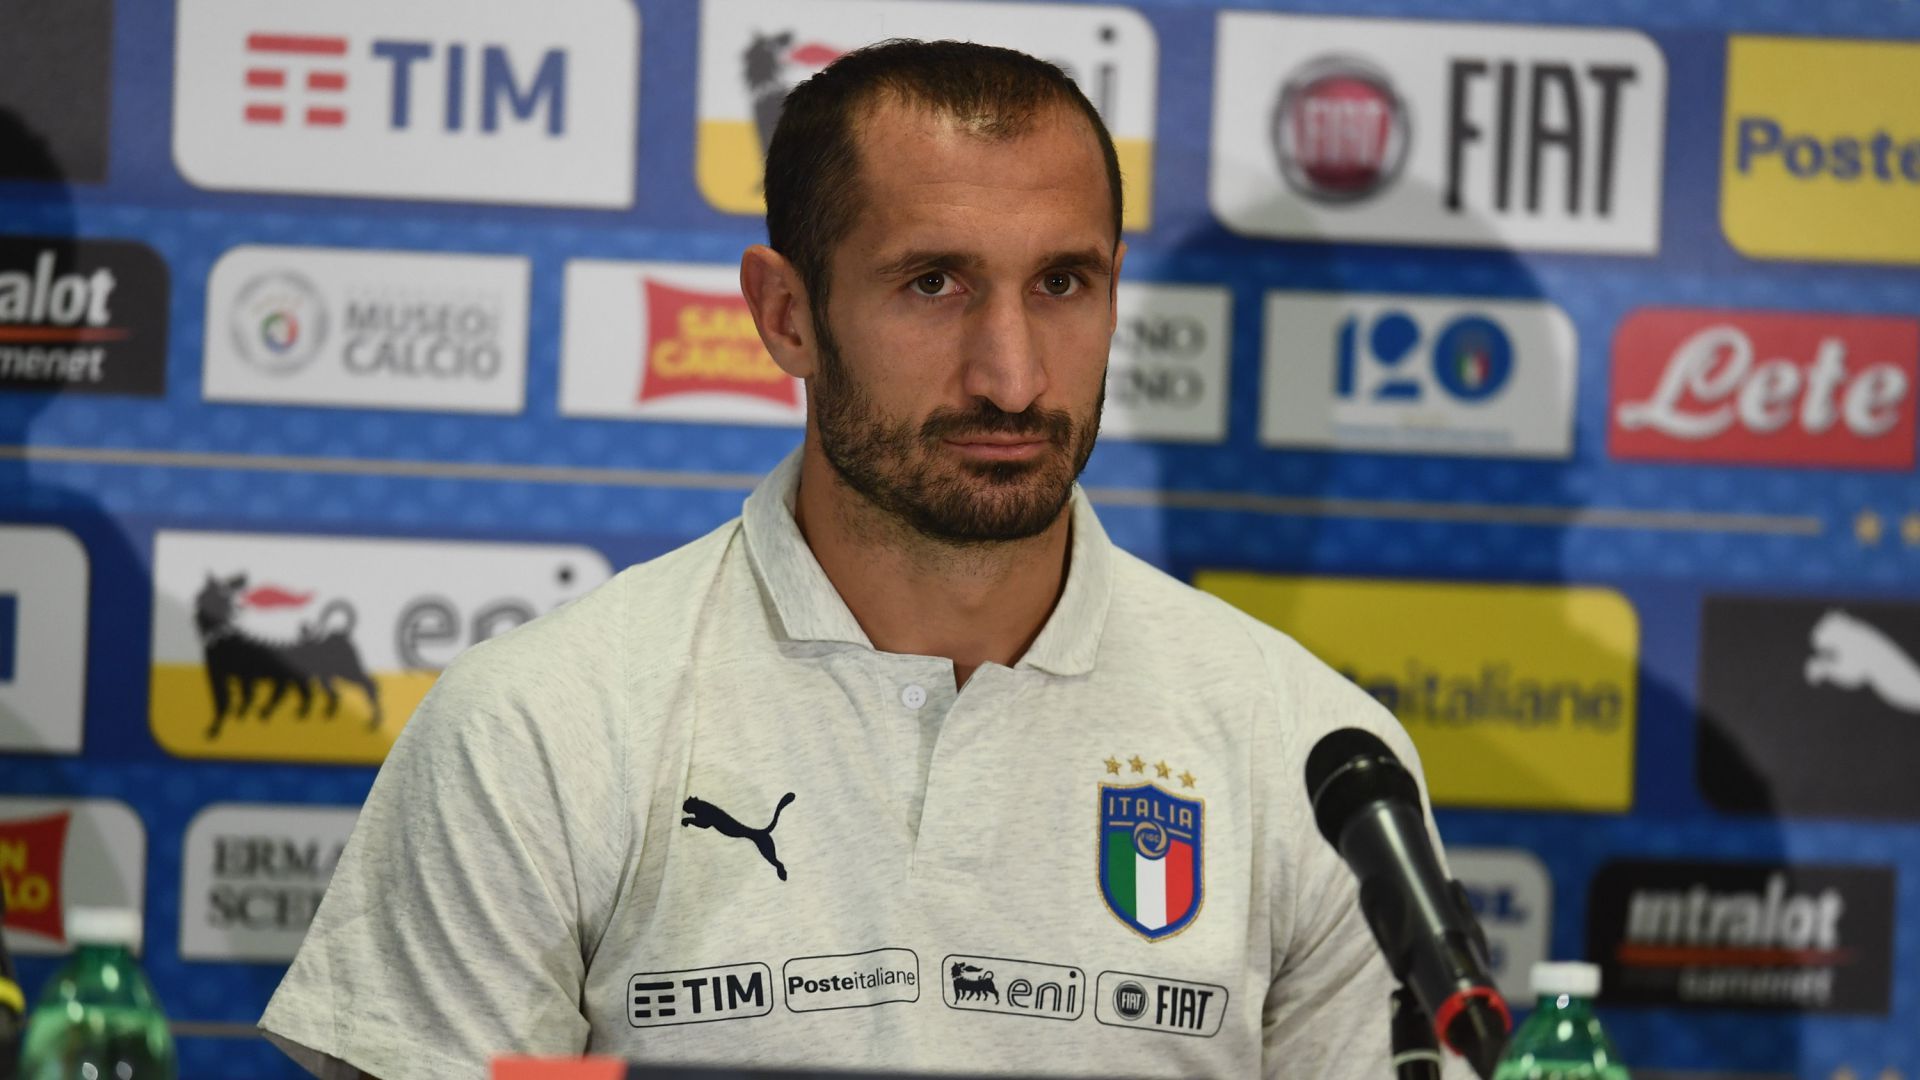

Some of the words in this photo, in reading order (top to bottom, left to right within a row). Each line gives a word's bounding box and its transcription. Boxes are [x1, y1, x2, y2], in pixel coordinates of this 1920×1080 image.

[370, 39, 569, 138] TIM
[1445, 57, 1638, 218] FIAT
[342, 335, 503, 382] CALCIO
[1618, 324, 1909, 440] Lete
[1108, 796, 1193, 830] ITALIA
[682, 971, 765, 1014] TIM
[787, 966, 917, 995] Posteitaliane
[1006, 970, 1077, 1013] eni
[1121, 991, 1143, 1011] FIAT
[1155, 984, 1214, 1031] FIAT
